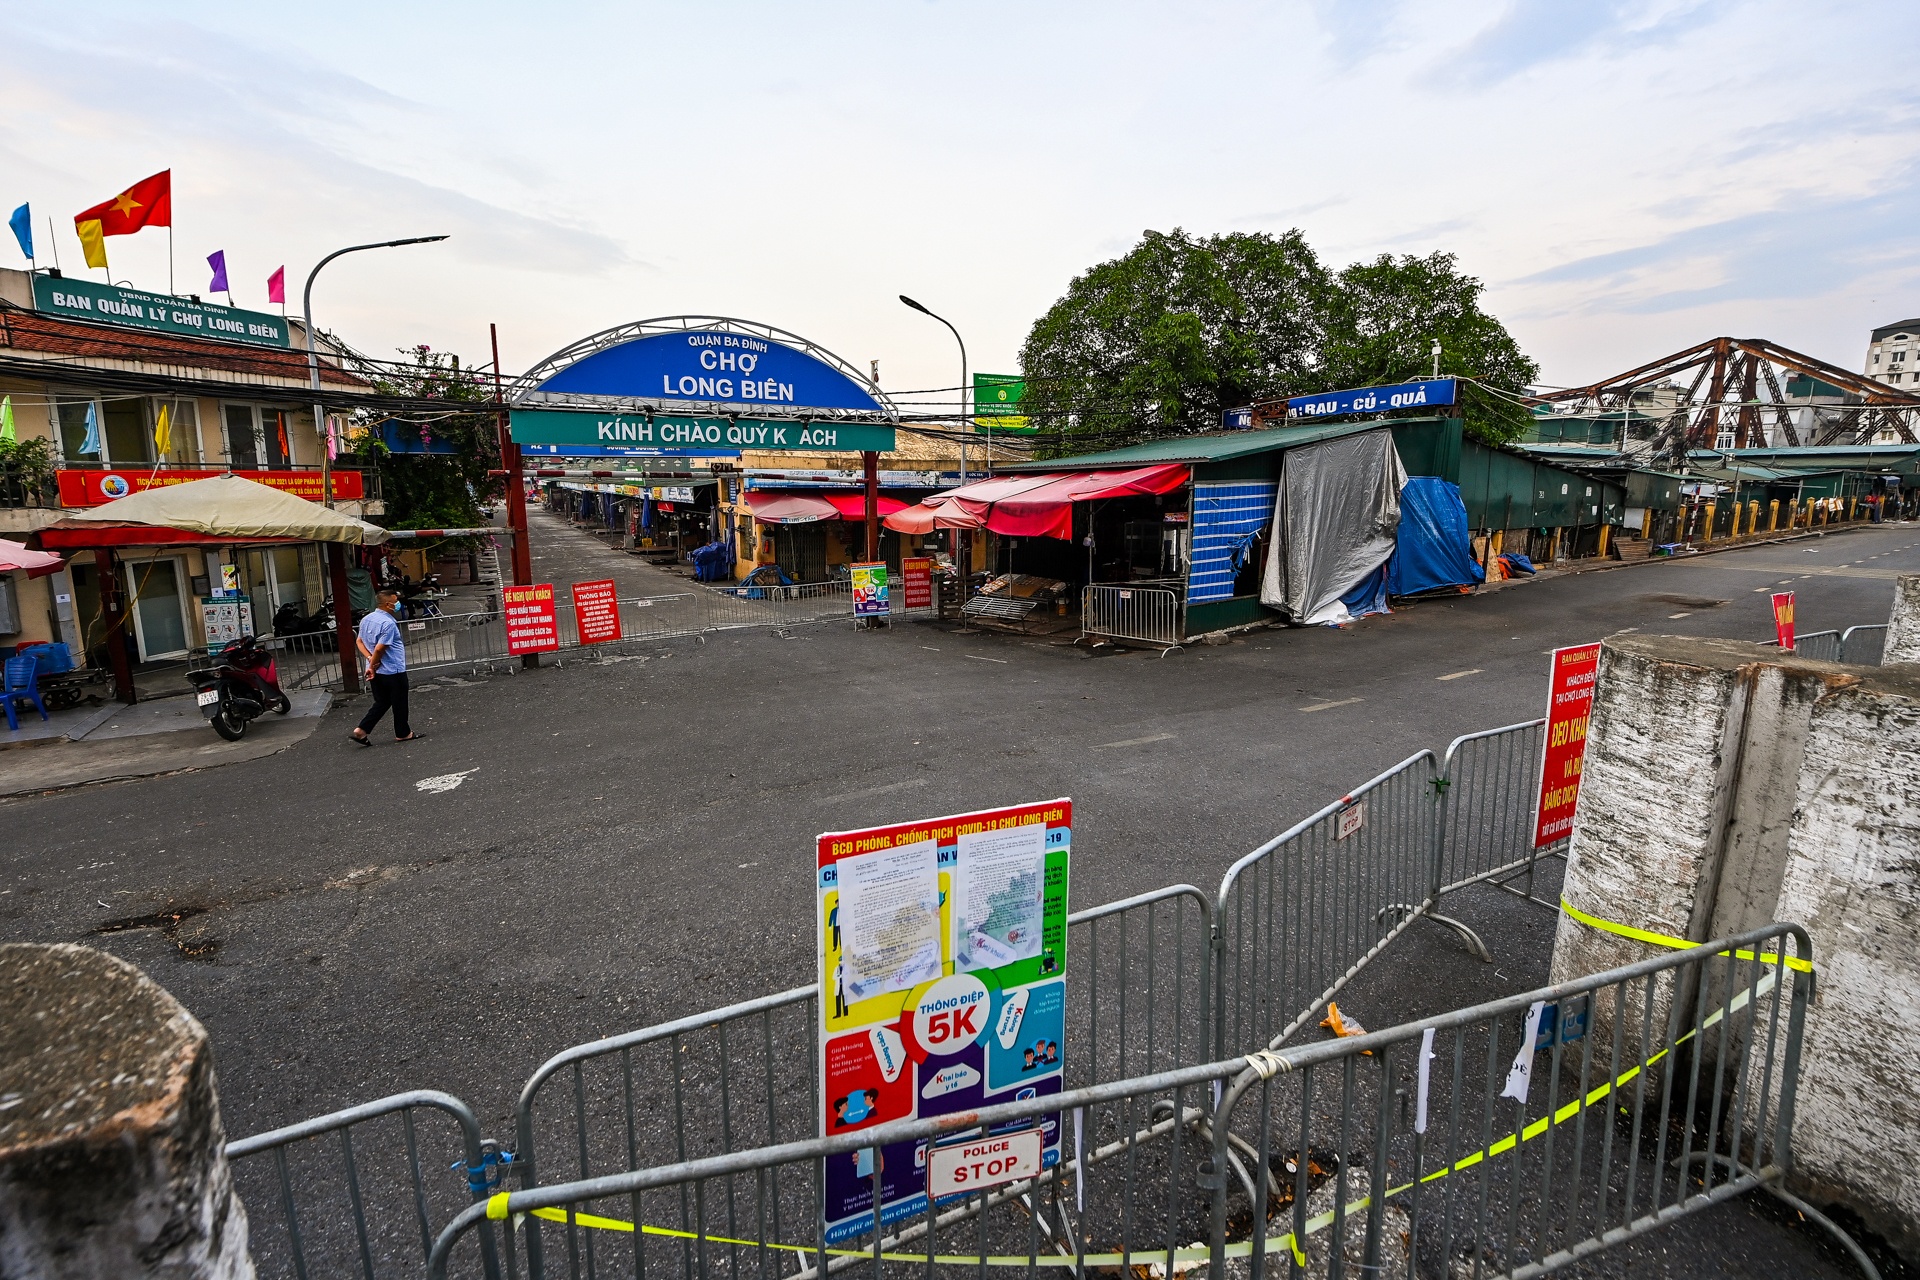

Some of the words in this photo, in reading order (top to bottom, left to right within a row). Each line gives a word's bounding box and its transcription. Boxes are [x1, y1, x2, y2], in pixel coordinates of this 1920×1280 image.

[119, 291, 151, 301] UBND
[154, 298, 186, 308] QUẬN
[204, 306, 228, 314] ĐÌNH
[53, 292, 91, 310] BAN
[98, 299, 143, 318] QUẢN
[149, 307, 166, 321] LÝ
[172, 311, 202, 329] CHỢ
[208, 317, 244, 334] LONG
[249, 324, 278, 338] BIÊN
[688, 335, 721, 348] QUẬN
[724, 336, 739, 347] BA
[742, 338, 767, 353] ĐÌNH
[700, 350, 758, 376] CHỢ
[664, 375, 734, 398] LONG
[741, 378, 794, 401] BIÊN
[1304, 402, 1337, 416] RAU
[1354, 392, 1375, 410] CỦ
[1390, 386, 1426, 406] QUẢ
[598, 418, 652, 441] KÍNH
[660, 420, 721, 443] CHÀO
[727, 424, 768, 445] QUÝ
[265, 476, 276, 485] NĂM
[288, 476, 293, 485] LÀ
[294, 477, 303, 485] GÓP
[304, 476, 315, 485] PHẦN
[506, 591, 512, 602] ĐỀ
[513, 591, 524, 604] NGHỊ
[525, 586, 534, 601] QUÝ
[535, 589, 551, 600] KHÁCH
[579, 591, 598, 600] THÔNG
[1562, 654, 1573, 664] BAN
[1573, 651, 1585, 662] QUẢN
[1586, 648, 1593, 660] LÝ
[1567, 672, 1584, 687] KHÁCH
[1556, 692, 1565, 704] TẠI
[1565, 689, 1575, 701] CHỢ
[1576, 688, 1589, 699] LONG
[1552, 720, 1569, 748] ĐEO
[1564, 758, 1573, 779] VÀ
[1544, 782, 1561, 812] BẰNG
[1562, 783, 1576, 809] DỊCH
[832, 843, 853, 856] BCĐ
[856, 834, 893, 852] PHÒNG,
[896, 827, 928, 846] CHỐNG
[931, 826, 953, 843] DỊCH
[956, 819, 996, 836] COVID-19
[999, 816, 1017, 830] CHỢ
[1019, 812, 1040, 826] LONG
[1043, 808, 1063, 822] BIÊN
[920, 998, 957, 1014] THÔNG
[960, 991, 984, 1005] ĐIỆP
[928, 1004, 977, 1044] 5K
[1000, 1016, 1009, 1036] trung
[1009, 1008, 1023, 1033] Không
[876, 1031, 886, 1046] cách
[832, 1054, 845, 1062] cách
[832, 1061, 840, 1069] khi
[841, 1058, 852, 1066] tiếp
[883, 1045, 895, 1076] Khoảng
[832, 1067, 848, 1076] người
[849, 1064, 862, 1072] khác
[936, 1073, 954, 1084] Khai
[955, 1070, 967, 1078] báo
[945, 1083, 950, 1091] y
[964, 1141, 1009, 1158] POLICE
[954, 1156, 1018, 1182] STOP
[830, 1227, 847, 1239] Hãy
[849, 1221, 863, 1233] giữ
[896, 1207, 910, 1216] cho
[912, 1201, 926, 1213] Bạn
